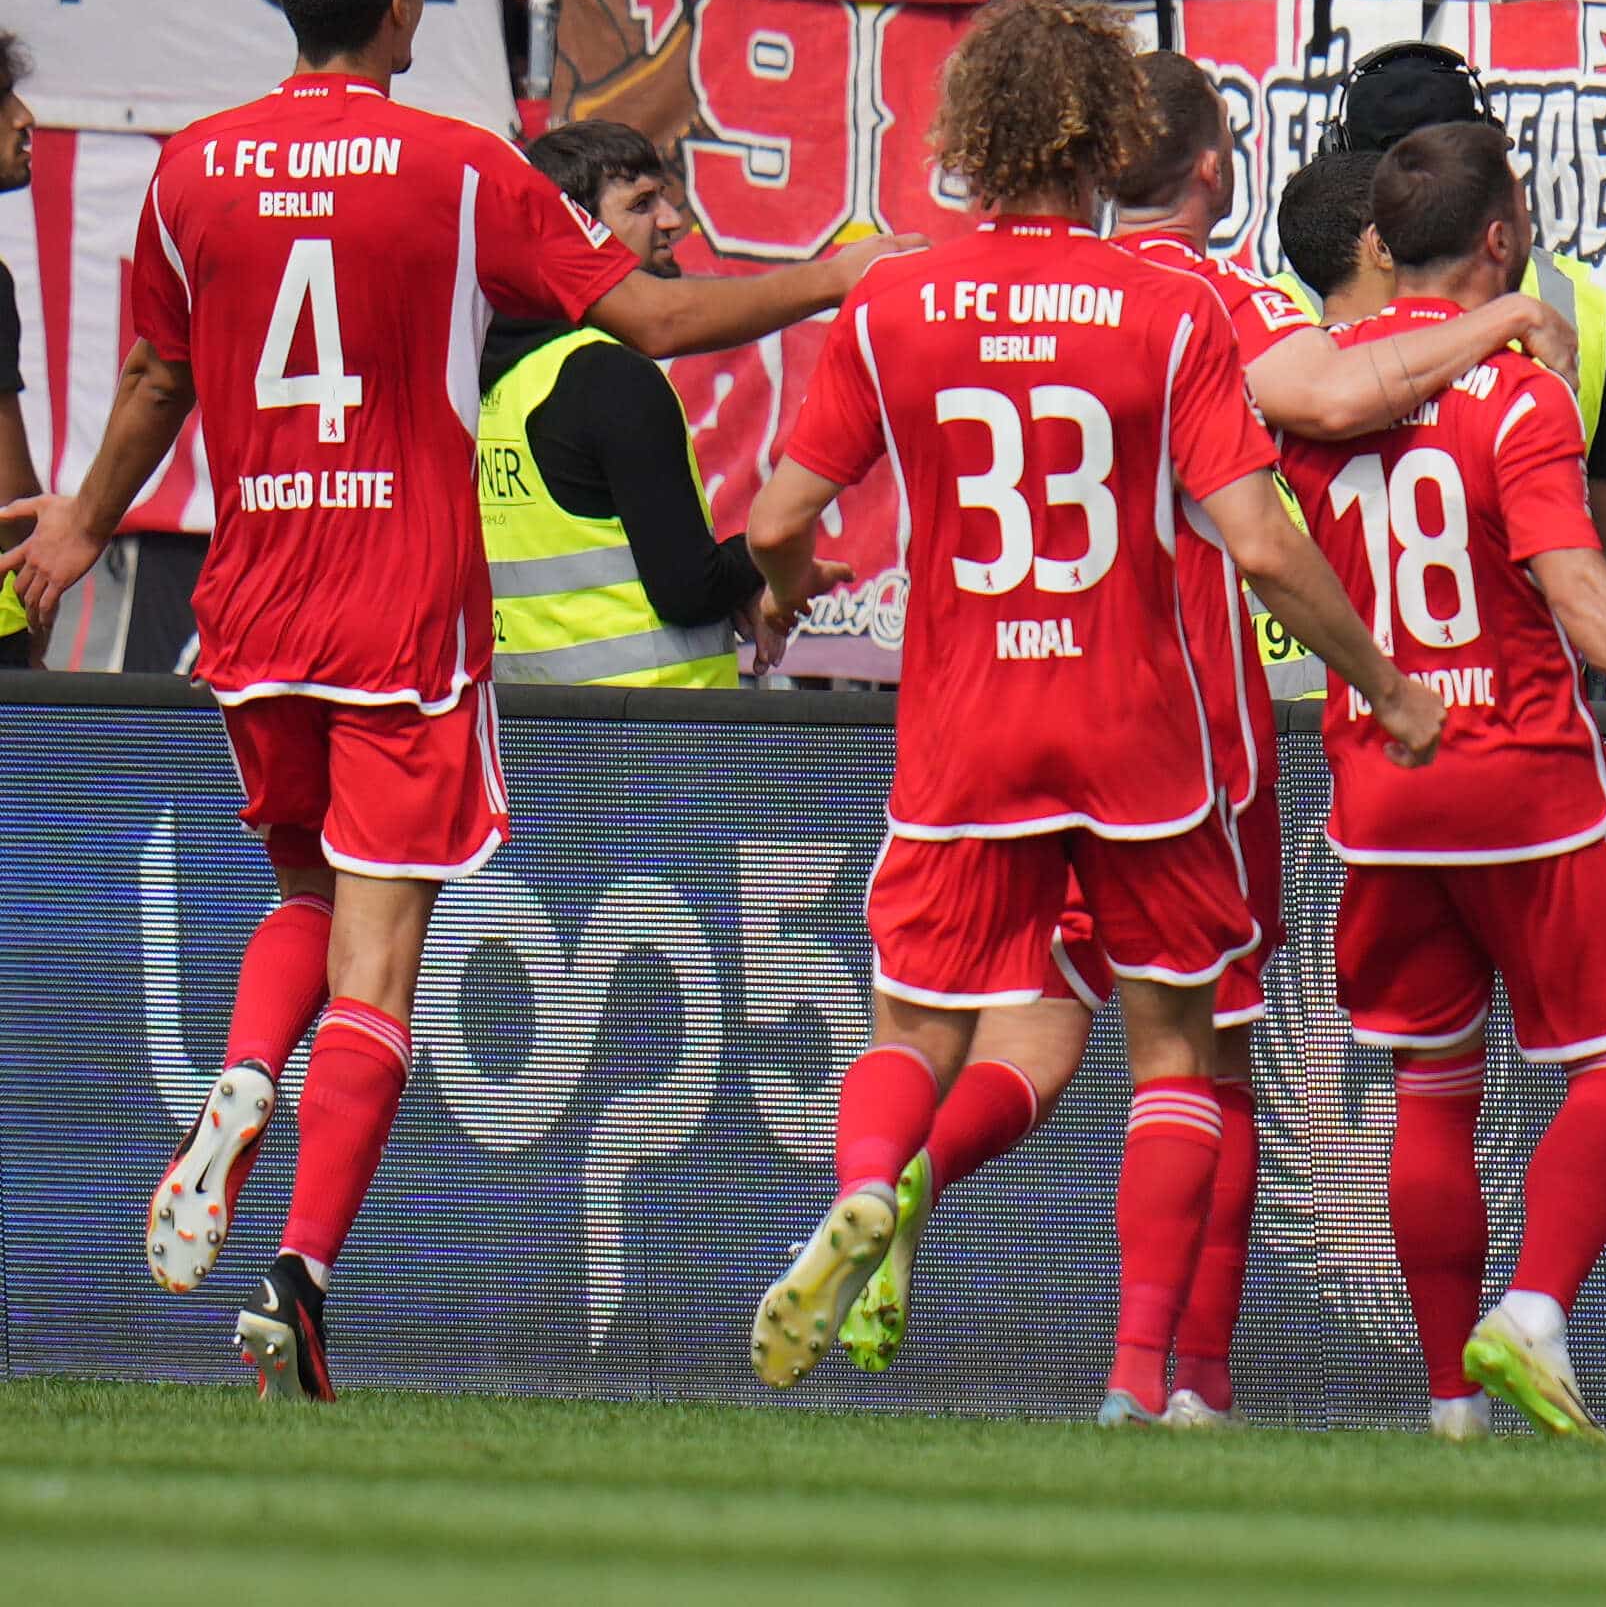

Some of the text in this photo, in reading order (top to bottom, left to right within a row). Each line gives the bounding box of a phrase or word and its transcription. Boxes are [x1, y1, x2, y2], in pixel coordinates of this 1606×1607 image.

[203, 138, 402, 186] 1. FC UNION
[259, 191, 335, 219] BERLIN
[920, 282, 1124, 328] 1. FC UNION
[256, 239, 363, 444] 4
[980, 335, 1057, 364] BERLIN
[320, 471, 395, 510] LEITE
[936, 385, 1120, 595] 33
[1328, 447, 1482, 657] 18
[996, 618, 1082, 660] KRAL
